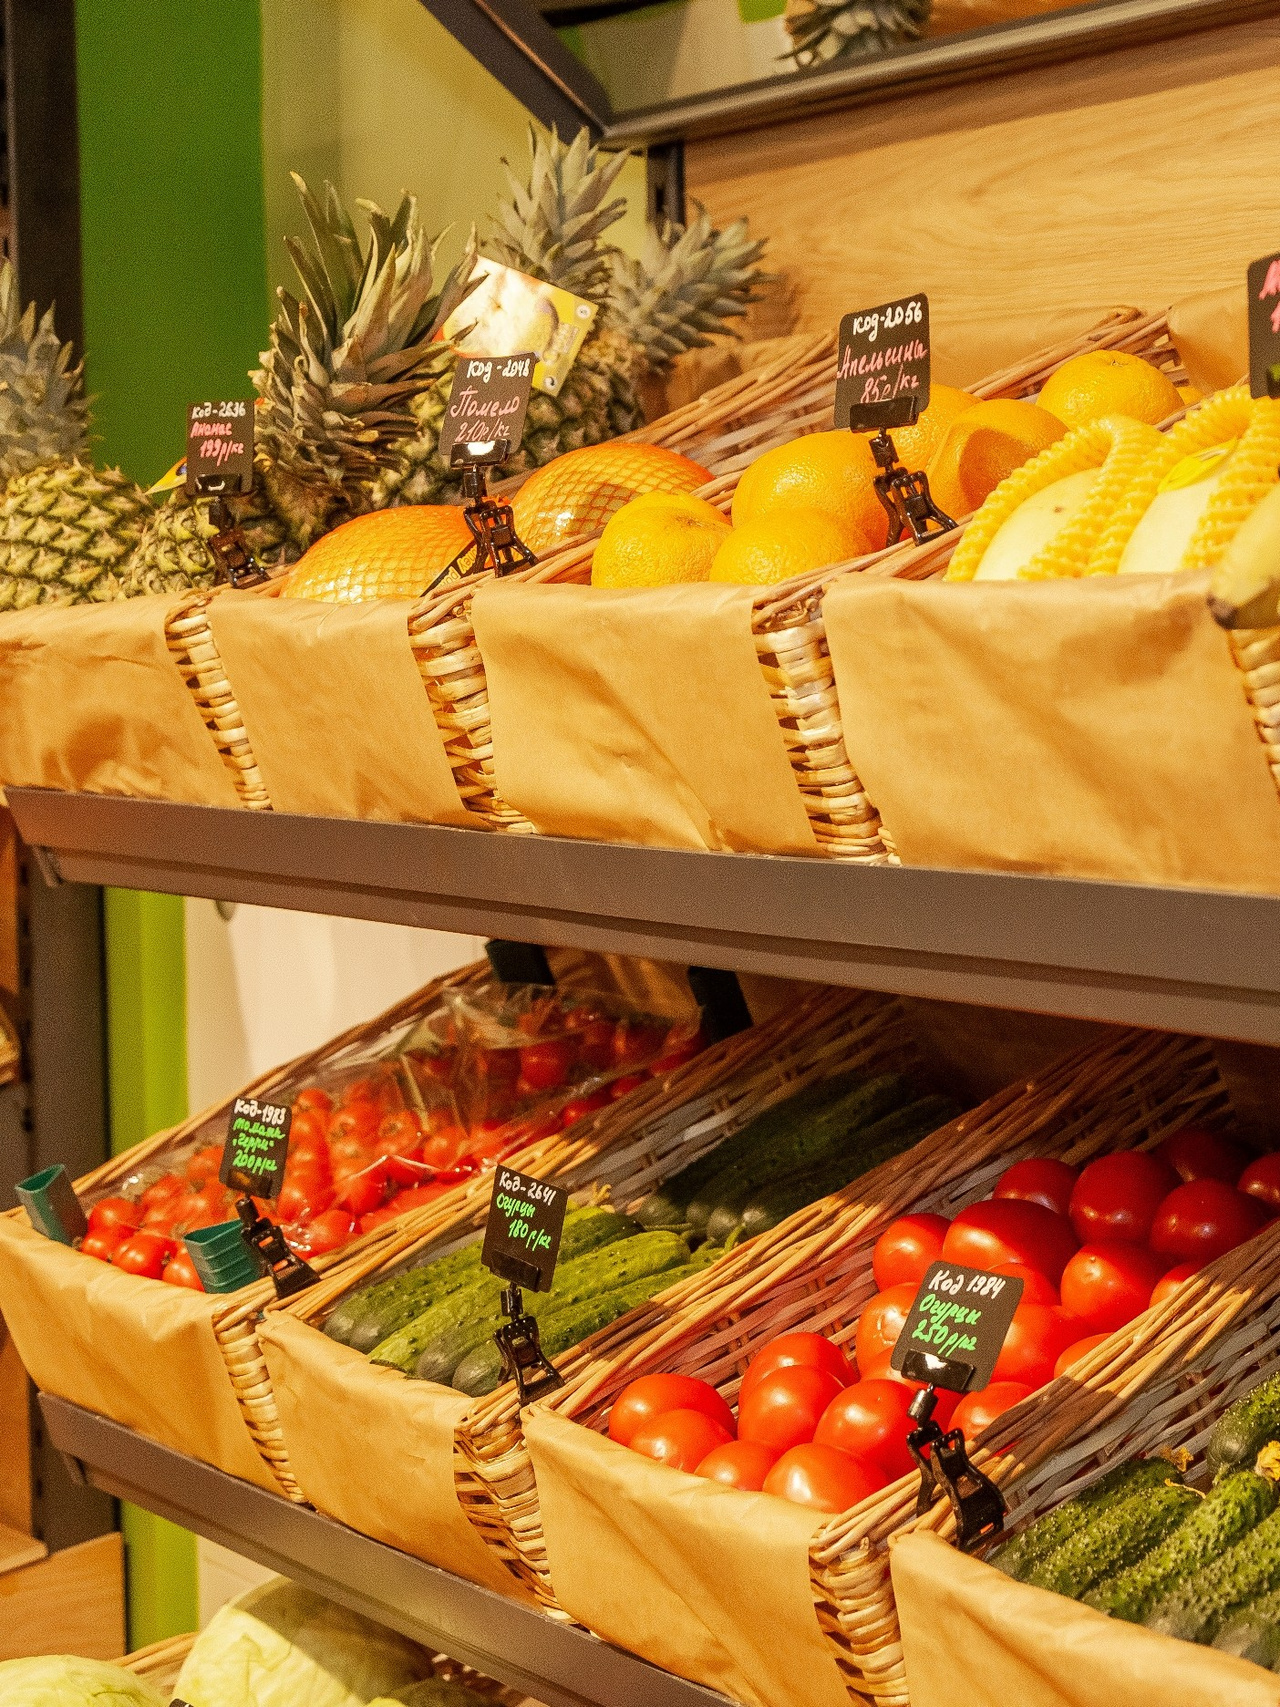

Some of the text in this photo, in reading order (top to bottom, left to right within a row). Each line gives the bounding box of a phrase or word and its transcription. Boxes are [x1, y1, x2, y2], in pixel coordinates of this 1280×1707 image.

[837, 339, 928, 379] Апельсины
[450, 385, 520, 417] Помело
[928, 1269, 1006, 1299] Код 1984
[919, 1293, 981, 1327] Огурцы
